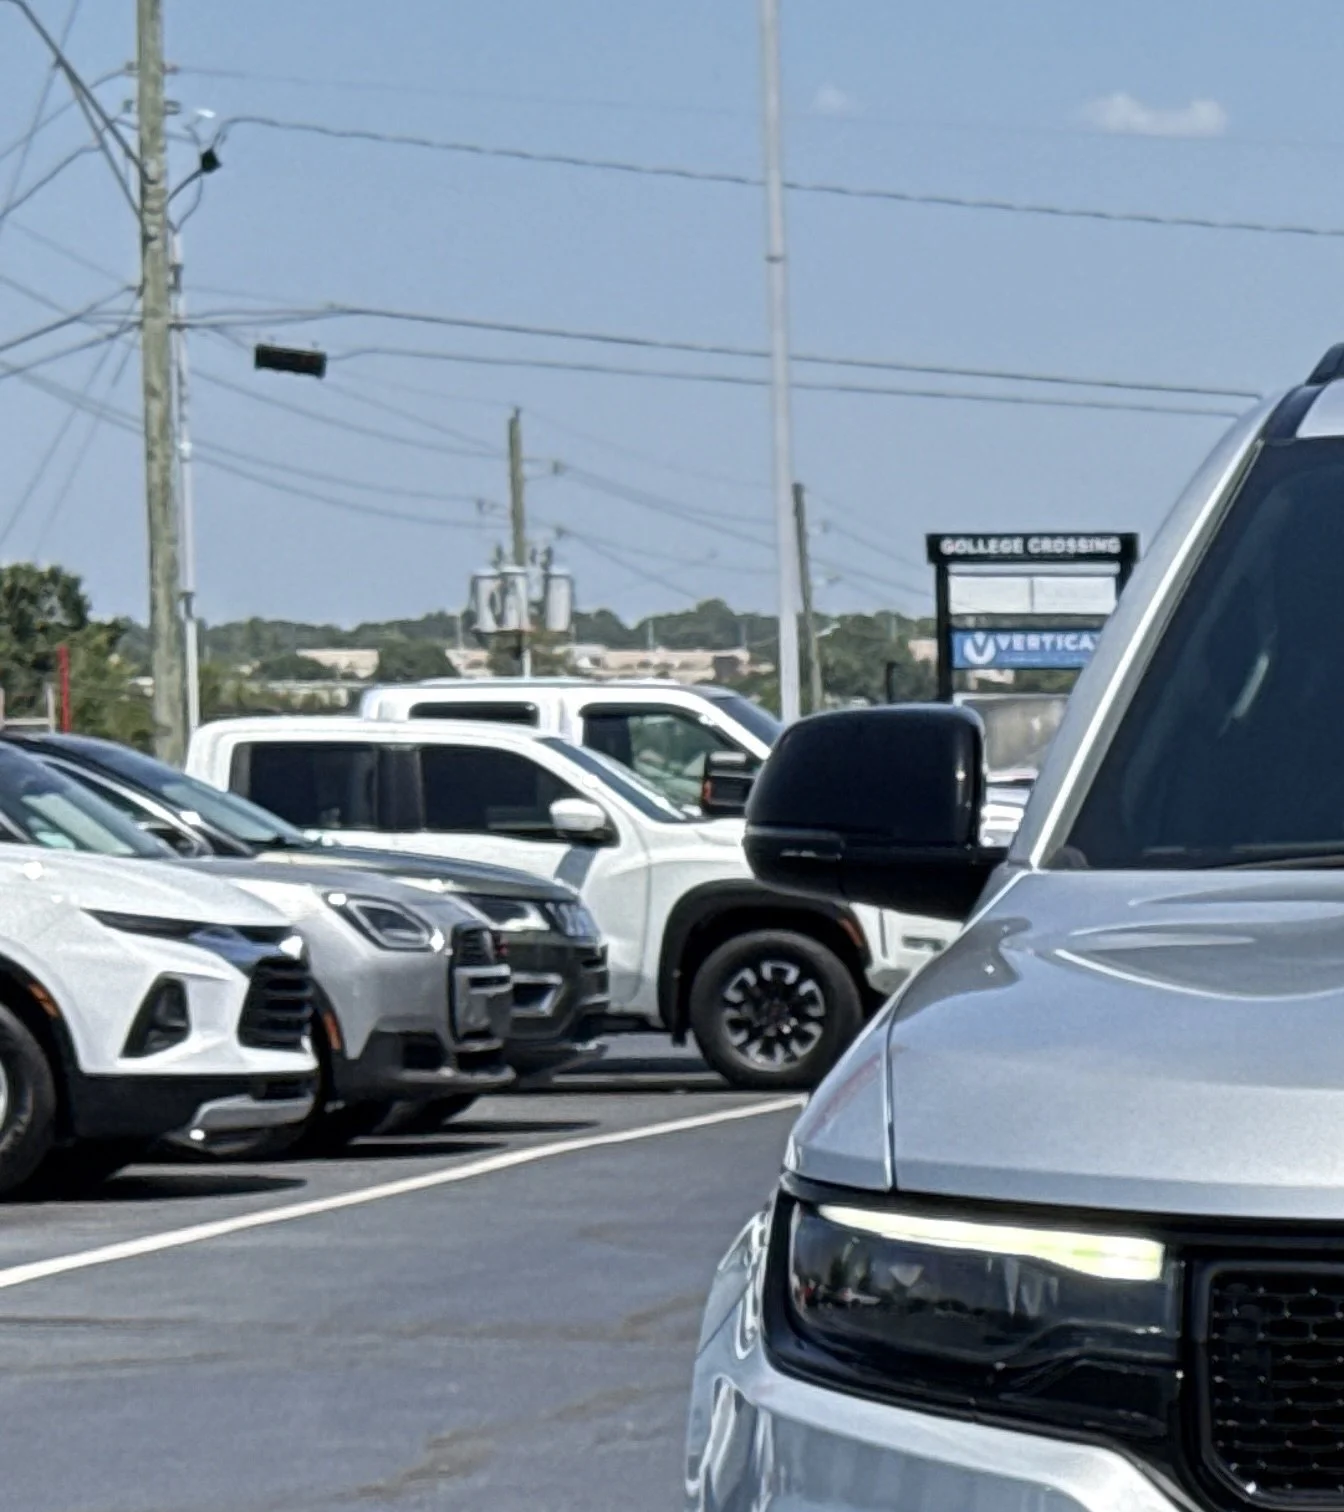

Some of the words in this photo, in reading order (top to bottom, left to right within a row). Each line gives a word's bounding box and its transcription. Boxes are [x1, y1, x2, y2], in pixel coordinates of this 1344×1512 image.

[940, 537, 1024, 554] COLLEGE
[1028, 536, 1121, 554] CROSSING
[996, 633, 1098, 651] VERTICA
